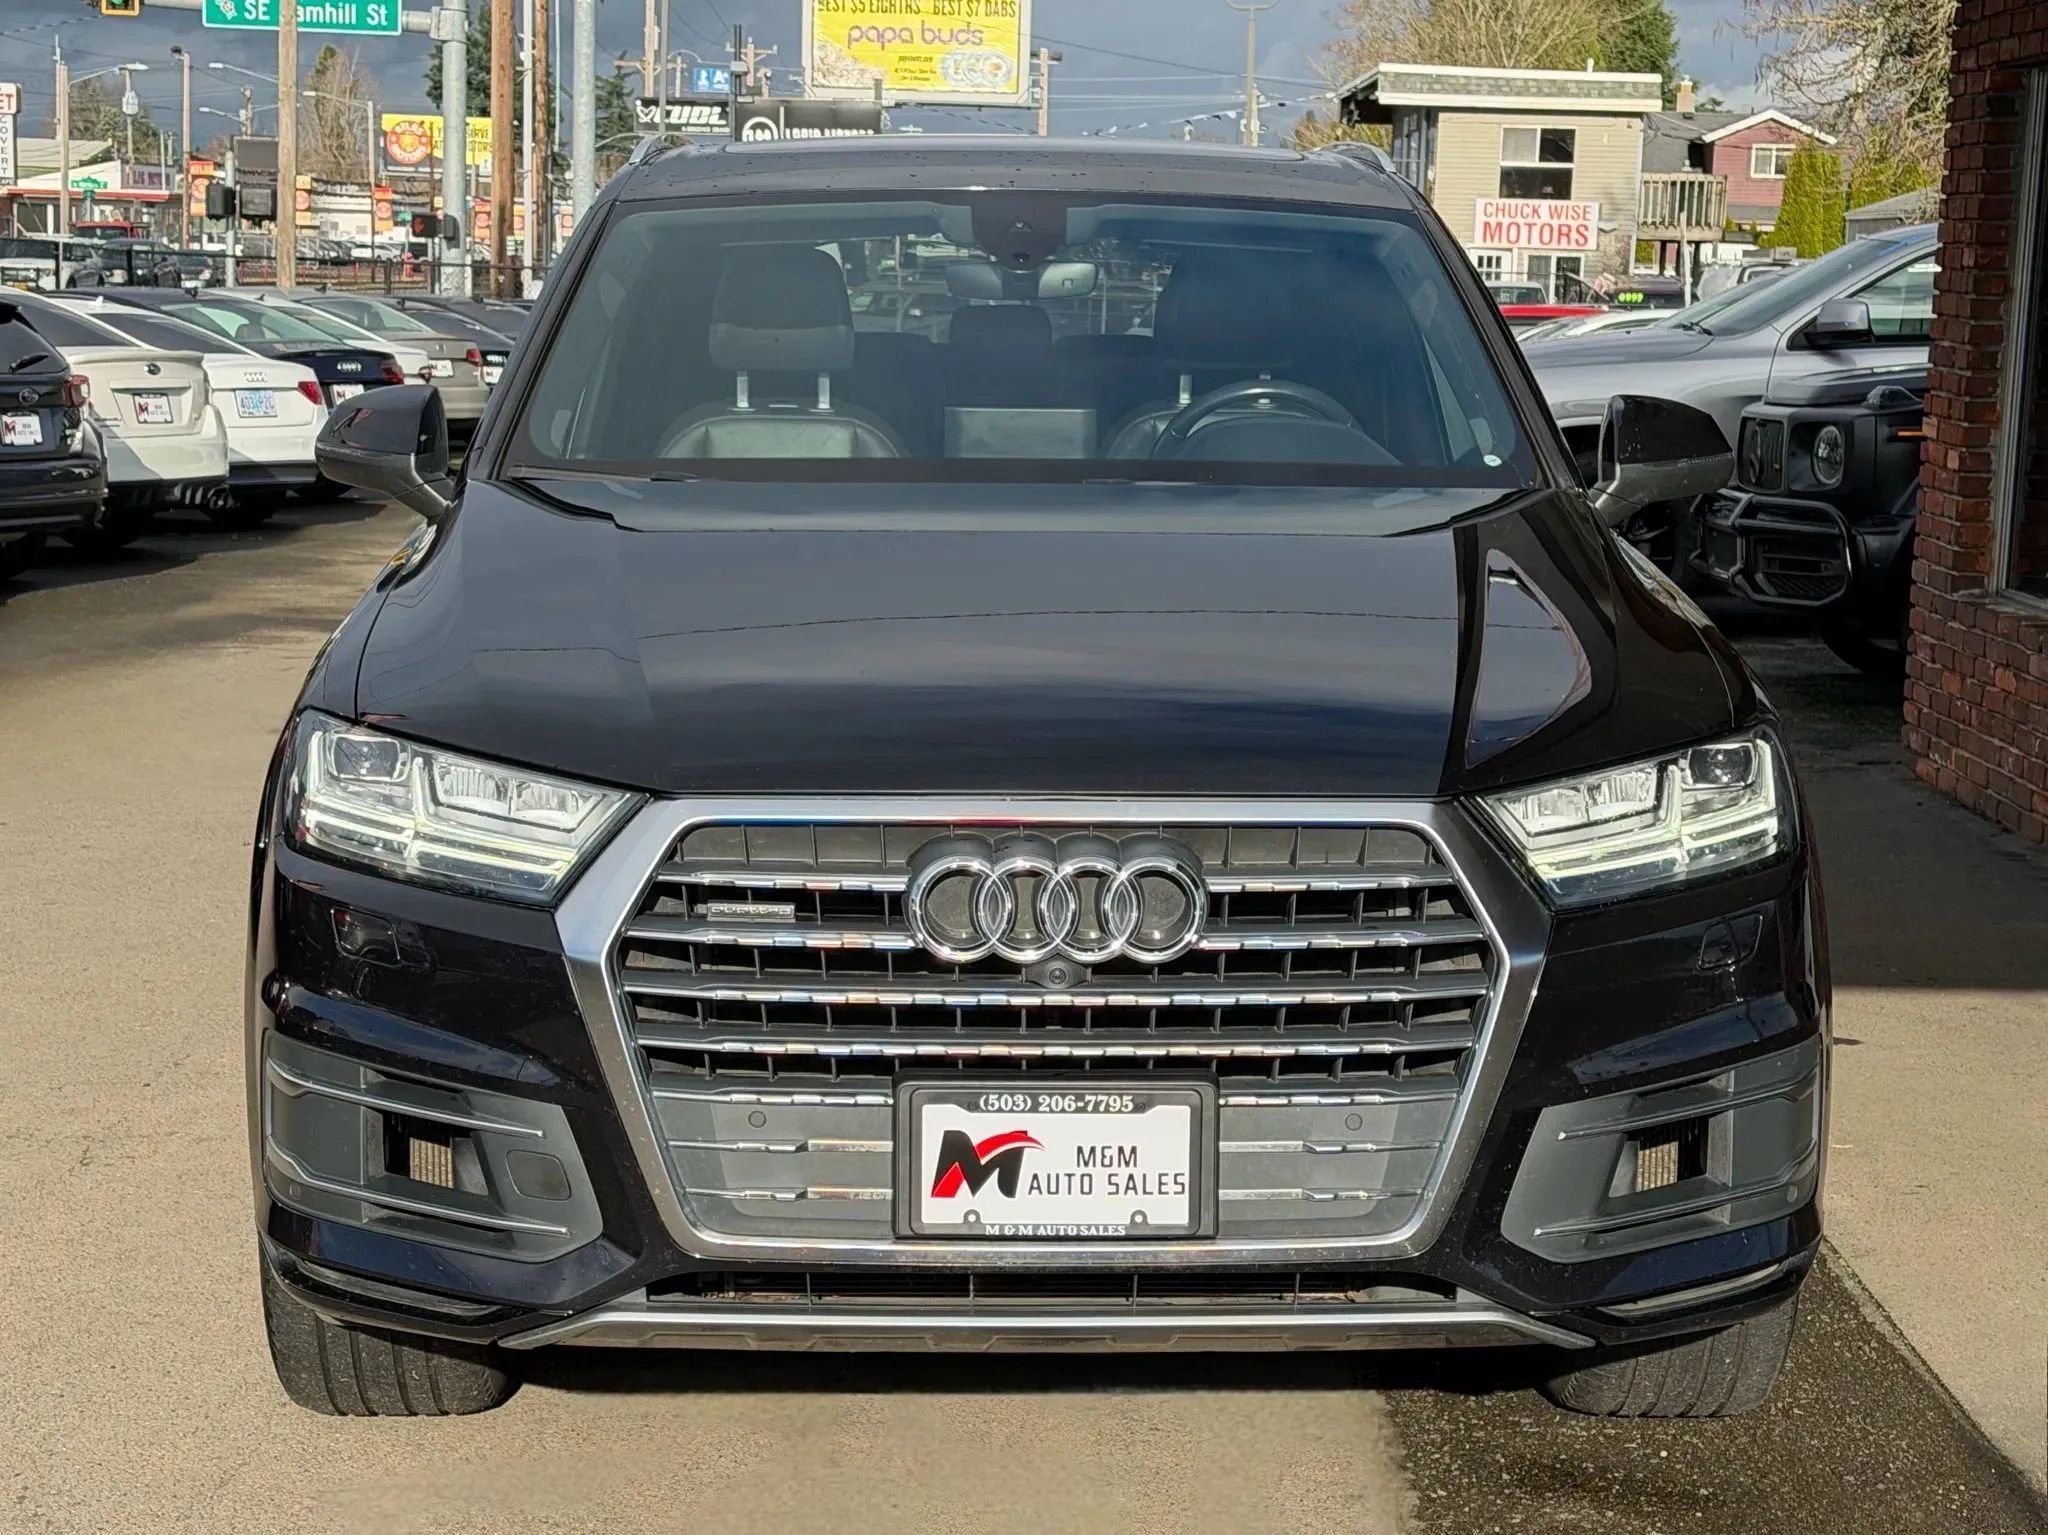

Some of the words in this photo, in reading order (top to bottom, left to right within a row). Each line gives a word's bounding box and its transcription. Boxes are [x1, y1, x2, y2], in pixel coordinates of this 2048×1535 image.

[244, 0, 270, 20] SE
[297, 3, 356, 25] amhill
[366, 4, 388, 26] St
[933, 0, 962, 16] BEST
[966, 0, 980, 17] $7
[984, 0, 1016, 18] DABS
[847, 24, 914, 50] papa
[921, 20, 984, 46] buds
[1484, 202, 1541, 219] CHUCK
[1549, 204, 1593, 221] WISE
[1483, 221, 1589, 247] MOTORS
[979, 1094, 1032, 1113] (503)
[1038, 1094, 1134, 1113] 206-7795
[1076, 1145, 1138, 1168] M&M
[1028, 1172, 1093, 1196] AUTO
[1107, 1172, 1186, 1196] SALES
[985, 1224, 1000, 1236] M
[1003, 1224, 1016, 1236] &
[1018, 1224, 1035, 1236] M
[1037, 1224, 1078, 1236] AUTO
[1080, 1224, 1126, 1236] SALES
